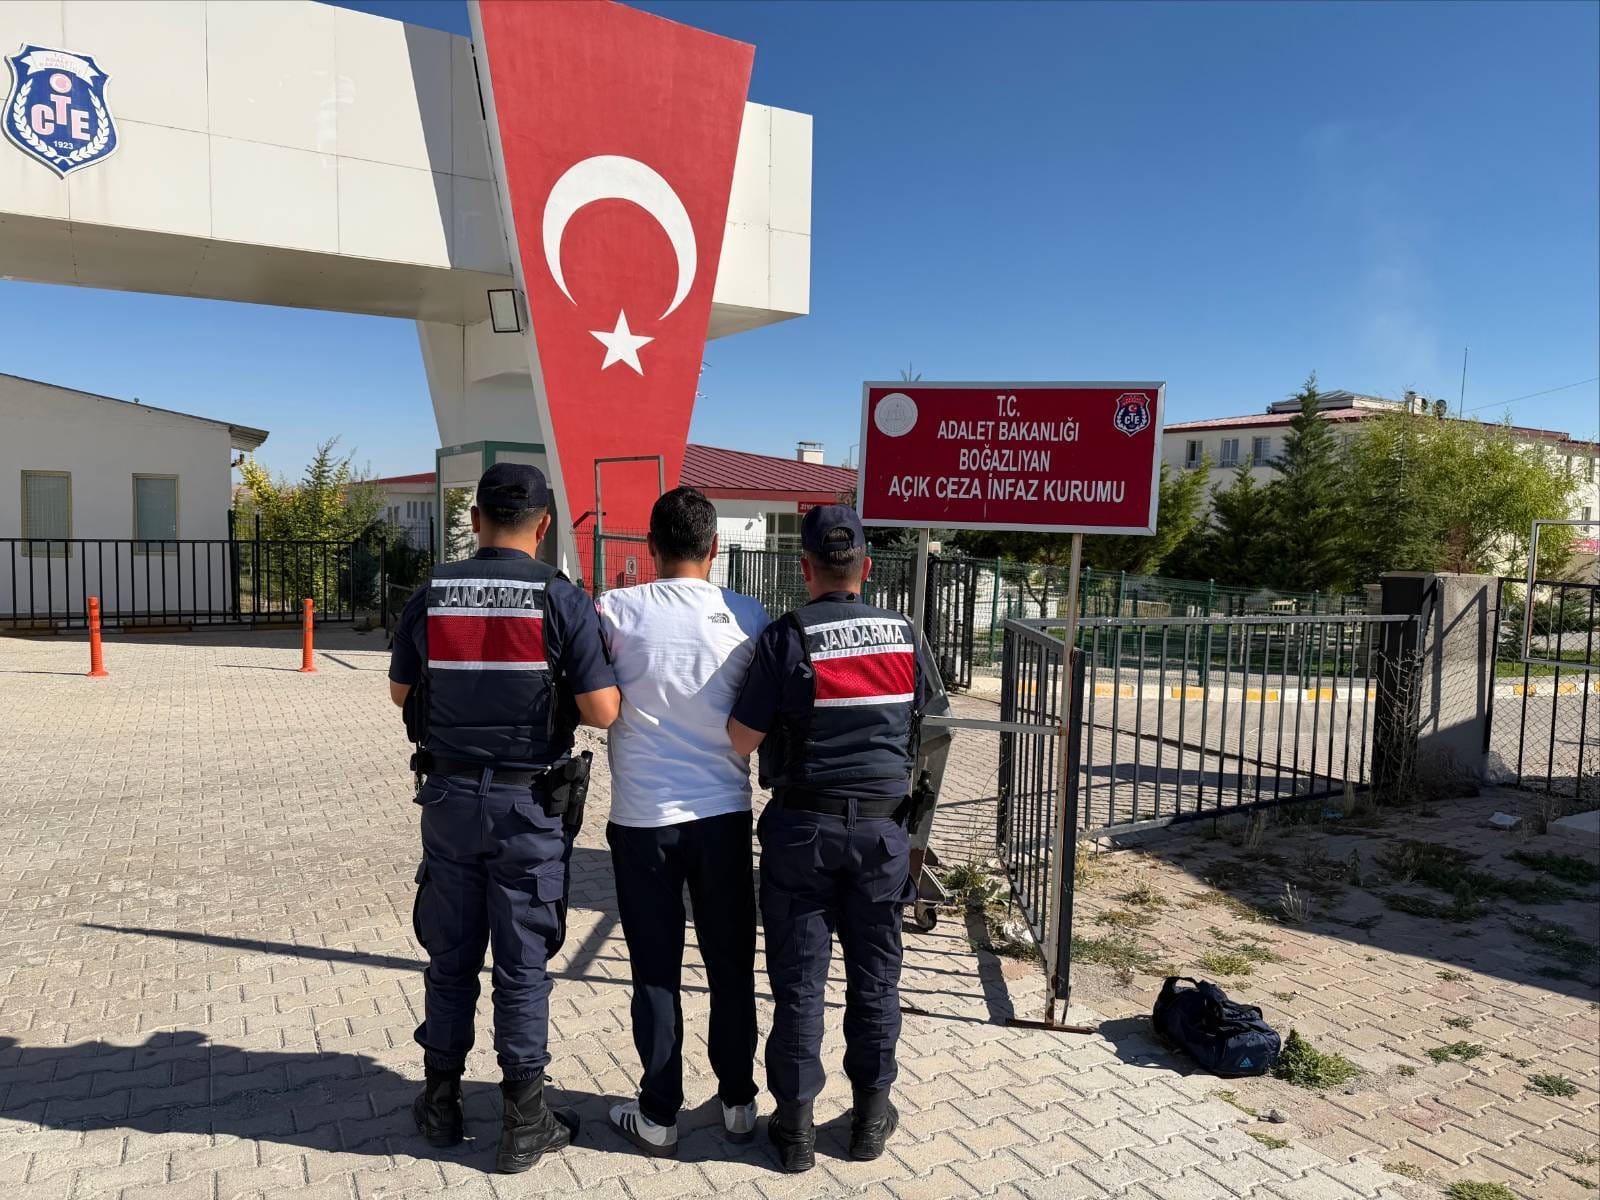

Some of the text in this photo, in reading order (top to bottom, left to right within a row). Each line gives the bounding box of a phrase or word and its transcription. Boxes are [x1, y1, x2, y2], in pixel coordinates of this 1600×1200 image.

[31, 94, 91, 140] CTE
[53, 140, 74, 150] 1923
[996, 395, 1021, 417] T.C.
[1124, 412, 1140, 425] CTE
[937, 416, 1080, 442] ADALET BAKANLIĞI
[959, 443, 1051, 472] BOĞAZLIYAN
[888, 472, 1125, 503] AÇIK CEZA İNFAZ KURUMU
[438, 585, 536, 609] JANDARMA
[820, 624, 906, 651] JANDARMA
